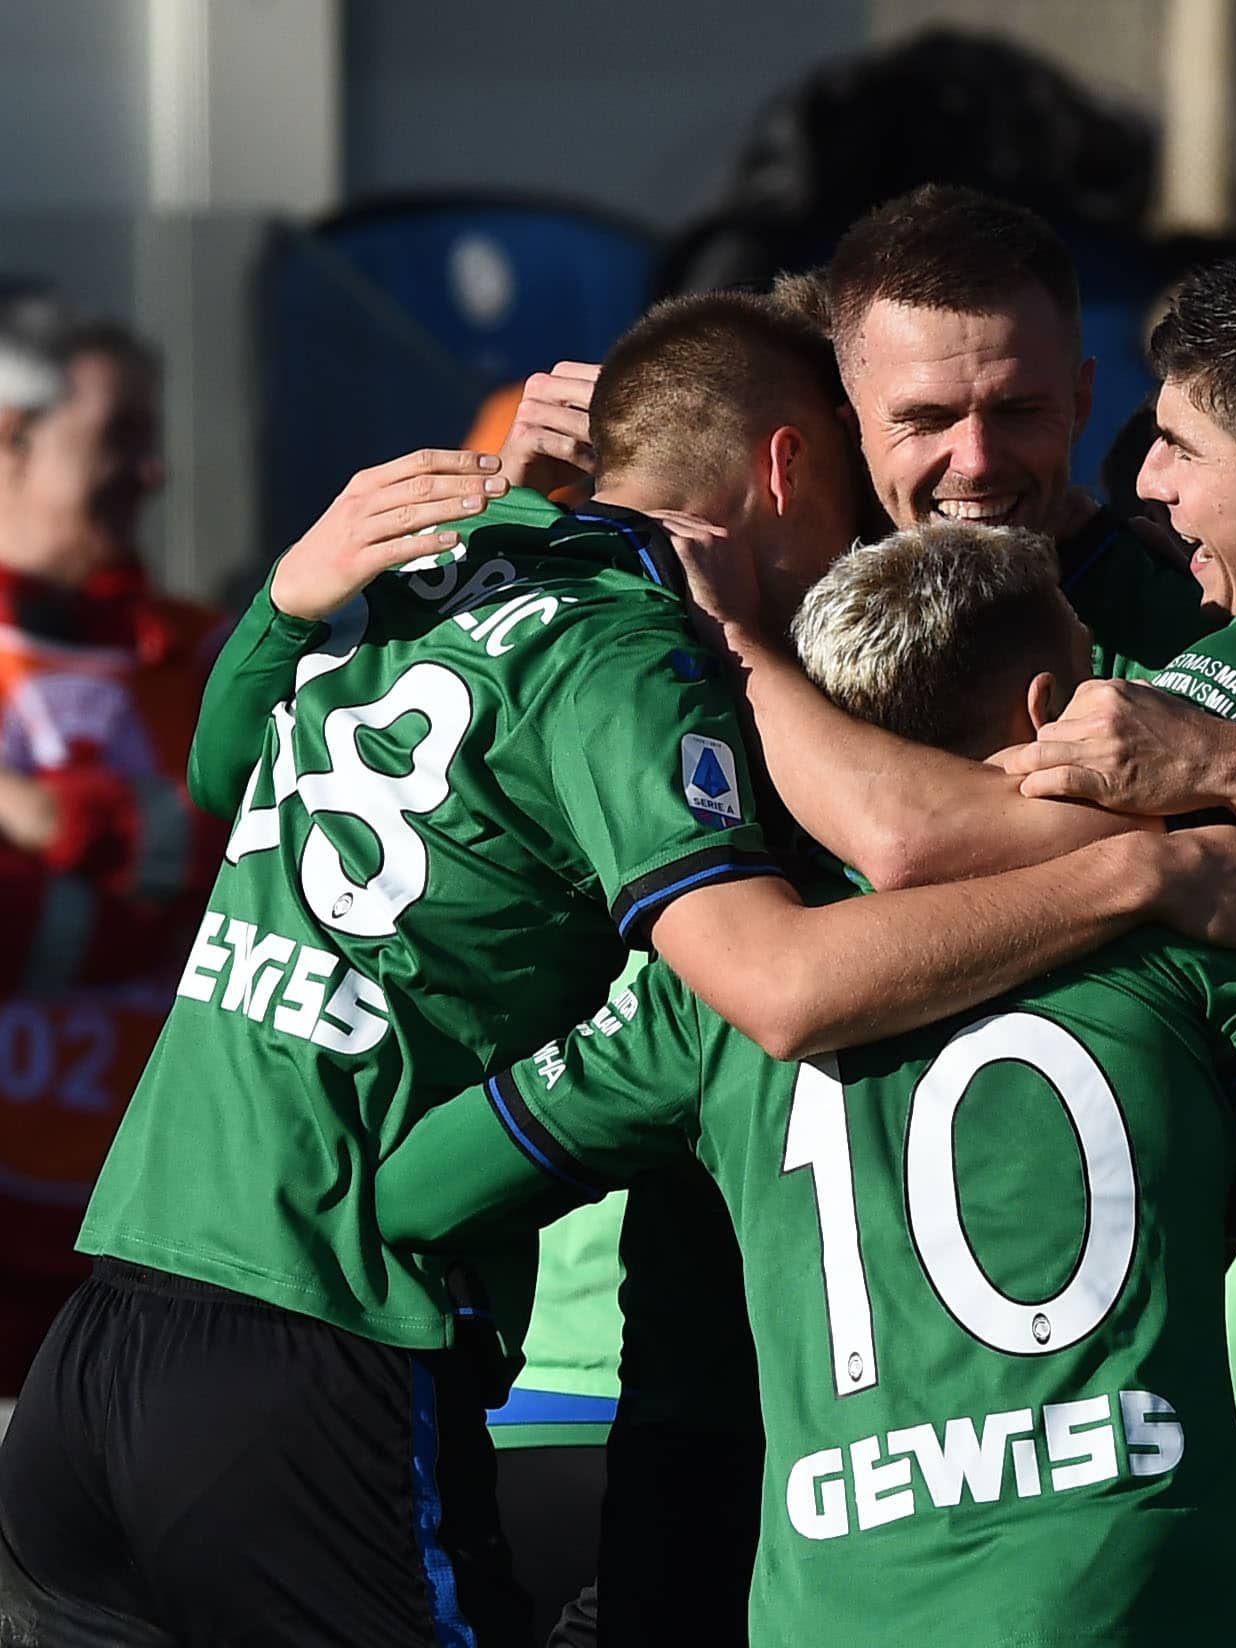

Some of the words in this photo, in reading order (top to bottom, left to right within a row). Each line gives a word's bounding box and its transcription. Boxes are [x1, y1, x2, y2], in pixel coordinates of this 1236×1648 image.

[692, 797, 726, 812] SERIE
[726, 805, 735, 815] A
[781, 1010, 1140, 1397] 10
